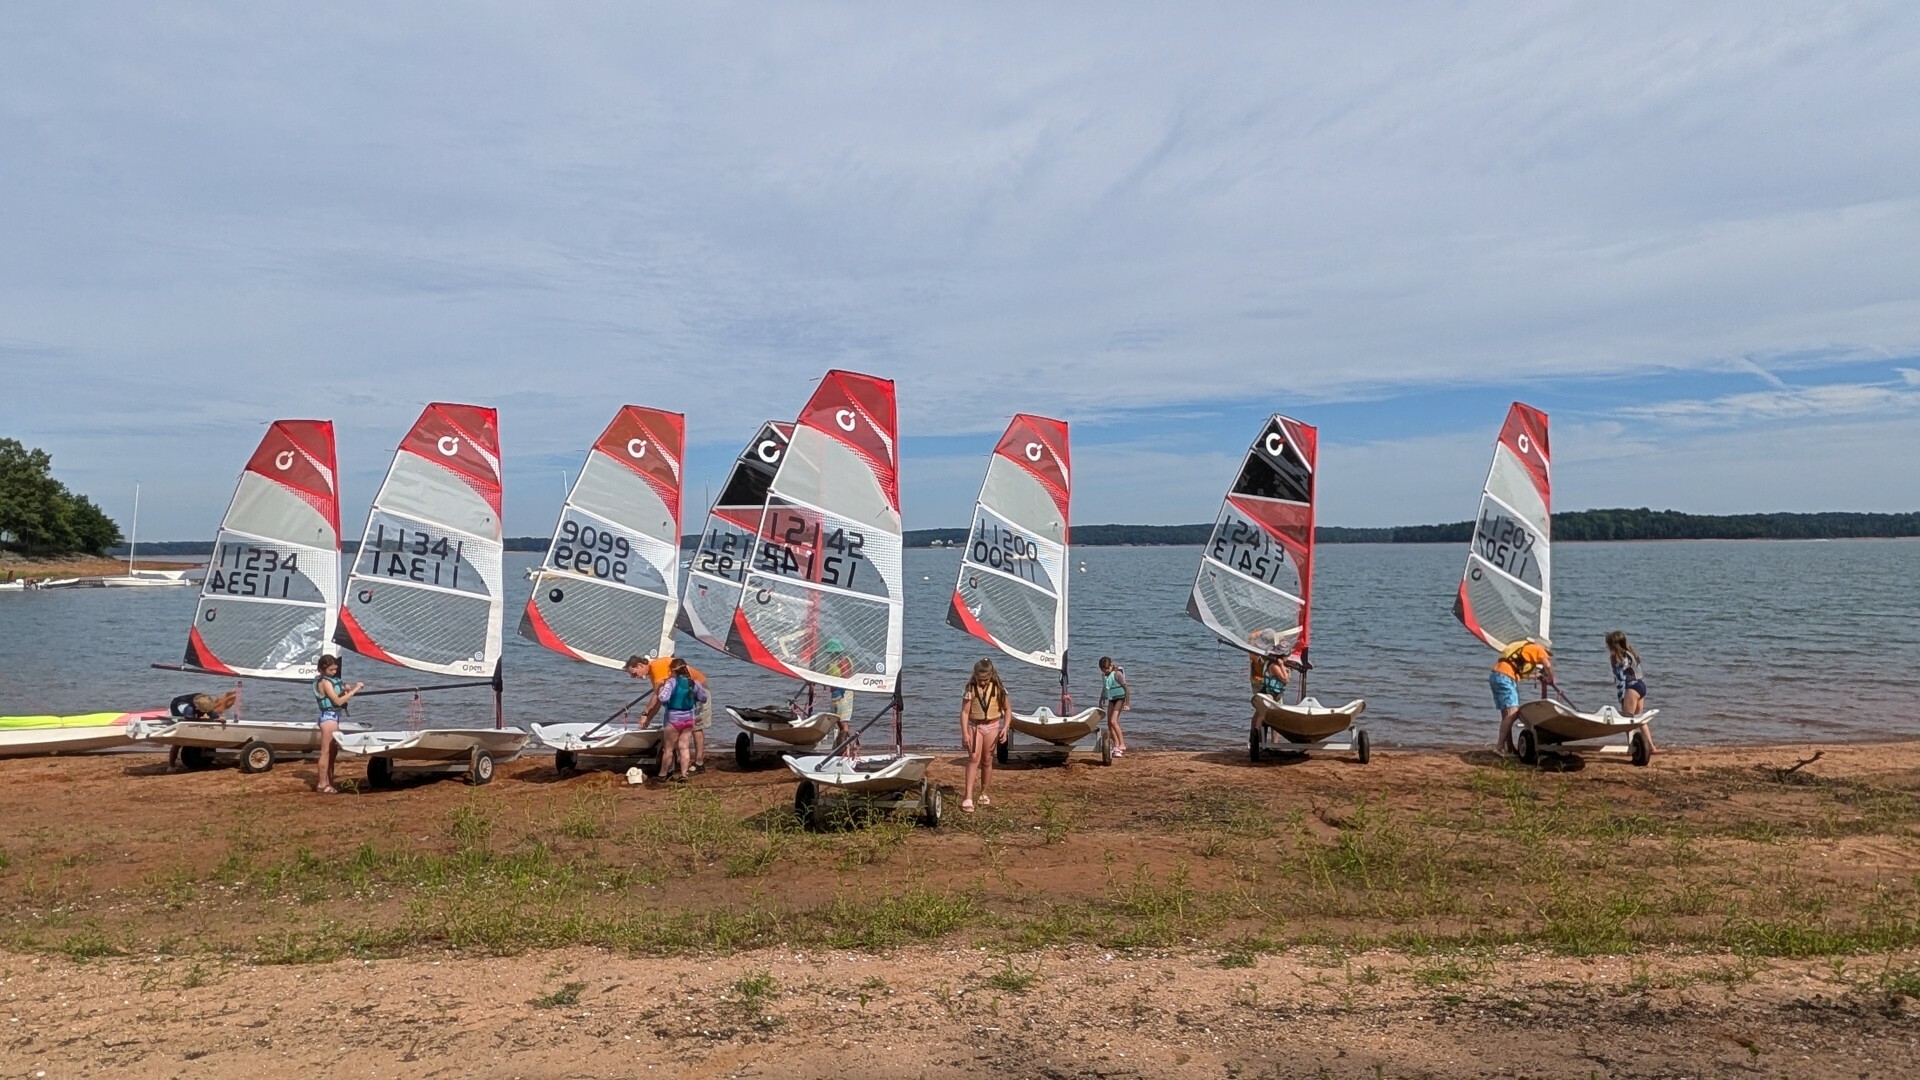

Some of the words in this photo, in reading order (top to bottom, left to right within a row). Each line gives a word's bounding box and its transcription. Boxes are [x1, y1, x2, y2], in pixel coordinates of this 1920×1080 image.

[375, 523, 463, 563] 11341
[560, 520, 630, 559] 9099
[770, 511, 865, 560] 12142
[981, 518, 1038, 562] 11200
[1222, 515, 1285, 562] 12413
[1481, 508, 1536, 554] 11207
[220, 544, 298, 574] 11234
